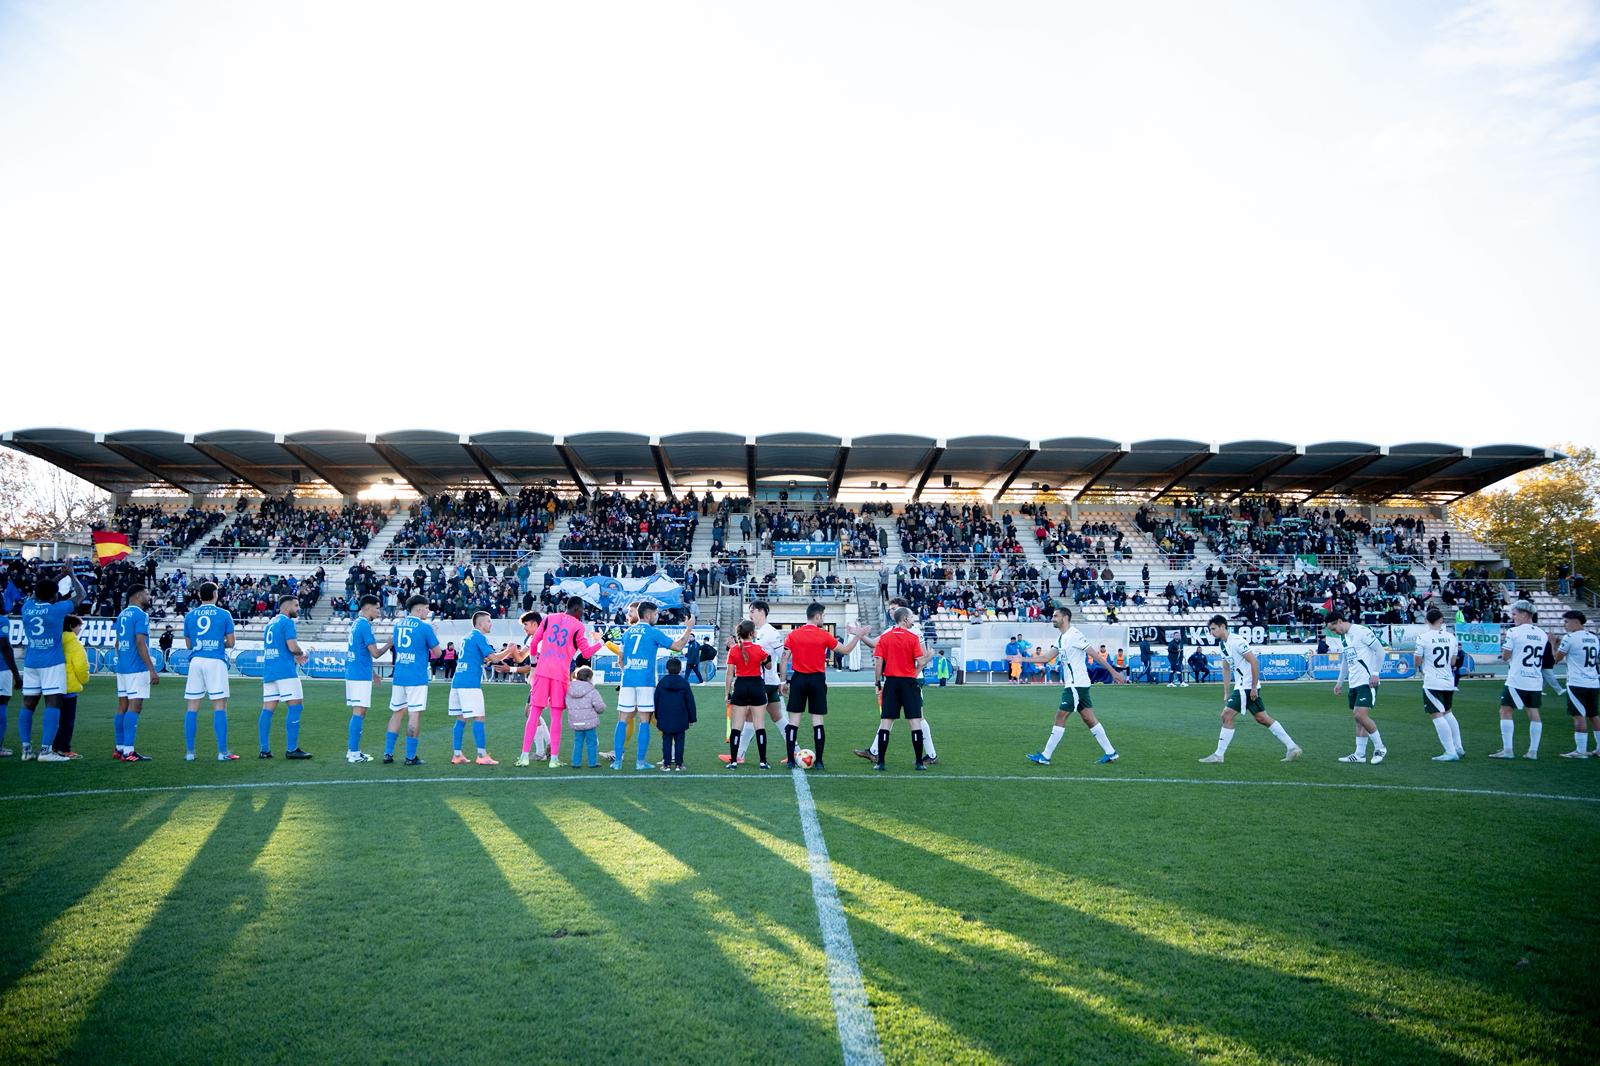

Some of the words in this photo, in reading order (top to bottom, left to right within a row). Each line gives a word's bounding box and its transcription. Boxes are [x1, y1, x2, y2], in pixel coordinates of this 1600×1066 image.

[30, 616, 45, 636] 3
[78, 620, 117, 646] ZUL
[120, 617, 127, 637] 5
[197, 616, 211, 636] 9
[265, 624, 275, 645] 6
[548, 624, 569, 648] 33
[397, 628, 413, 648] 15
[630, 634, 642, 654] 7
[1456, 632, 1499, 644] TOLEDO
[1432, 646, 1454, 669] 21
[1522, 645, 1543, 668] 25
[1582, 646, 1599, 668] 19
